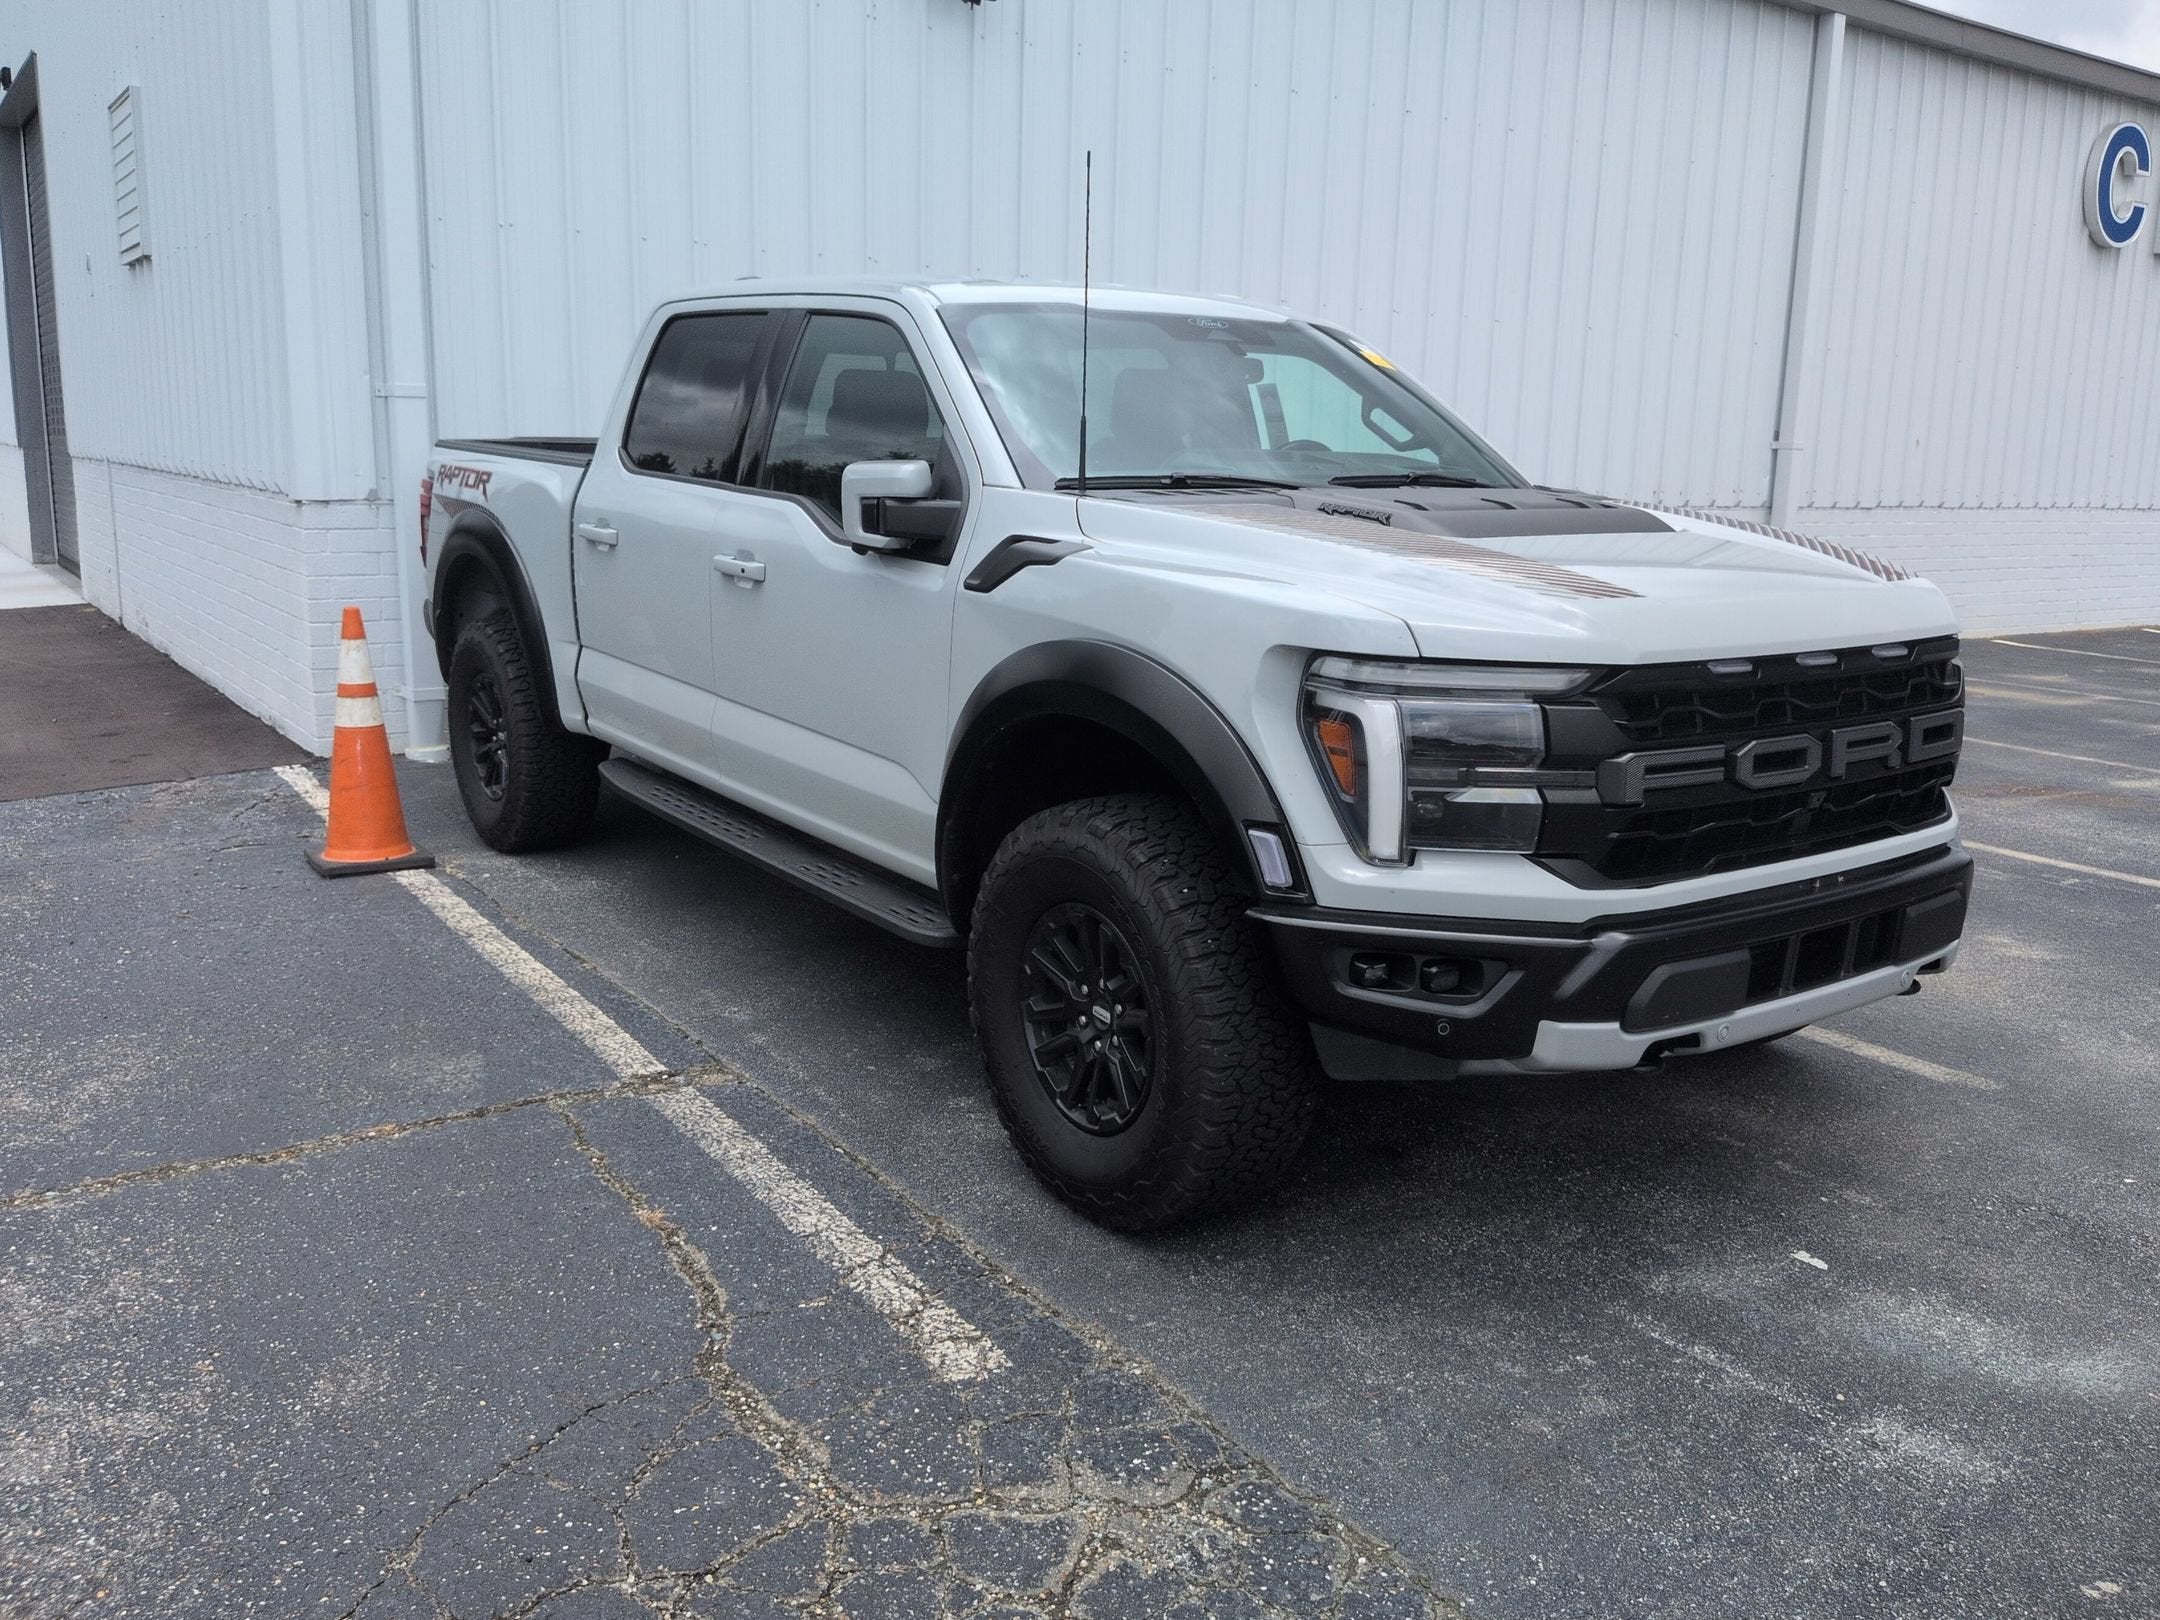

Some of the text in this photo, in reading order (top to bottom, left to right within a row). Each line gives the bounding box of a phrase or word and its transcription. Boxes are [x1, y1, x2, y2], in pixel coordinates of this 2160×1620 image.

[437, 464, 493, 502] RAPTOR
[1318, 502, 1392, 527] RAPTOR
[1600, 707, 1964, 803] FORD
